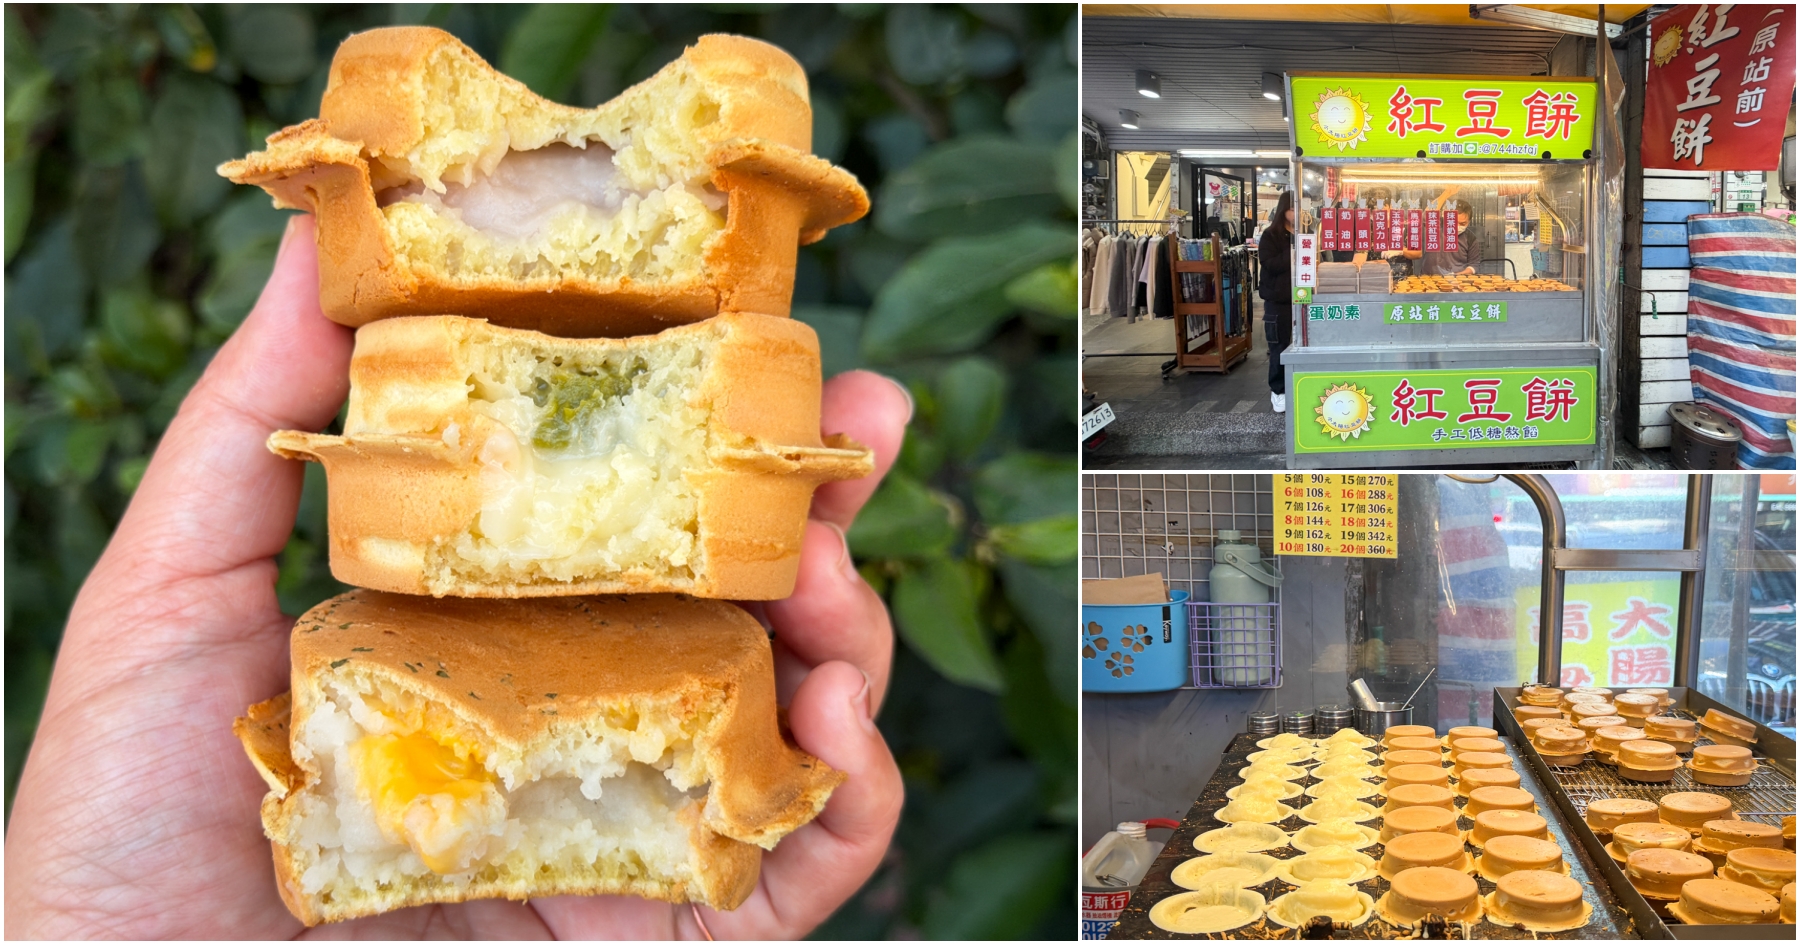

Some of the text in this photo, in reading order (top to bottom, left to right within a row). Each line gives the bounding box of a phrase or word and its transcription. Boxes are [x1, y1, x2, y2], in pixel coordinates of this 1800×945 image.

[1670, 4, 1740, 166] 紅豆餅
[1387, 85, 1581, 140] 紅豆餅
[1429, 142, 1463, 154] 訂購加
[1324, 210, 1334, 239] 紅豆
[1341, 210, 1352, 240] 奶油
[1357, 210, 1369, 239] 芋頭
[1375, 211, 1386, 240] 巧克力
[1324, 241, 1335, 249] 18
[1340, 242, 1352, 250] 18
[1358, 241, 1369, 249] 18
[1390, 241, 1401, 249] 18
[1427, 242, 1439, 250] 20
[1445, 242, 1457, 250] 20
[1301, 238, 1312, 283] 營業中
[1309, 304, 1361, 321] 蛋奶素
[1389, 304, 1501, 322] 原站前 紅豆餅
[1389, 377, 1578, 425] 紅豆餅
[1431, 425, 1539, 442] 手工低糖熬餡
[1610, 600, 1673, 686] 大腸
[1082, 895, 1126, 910] 瓦斯行
